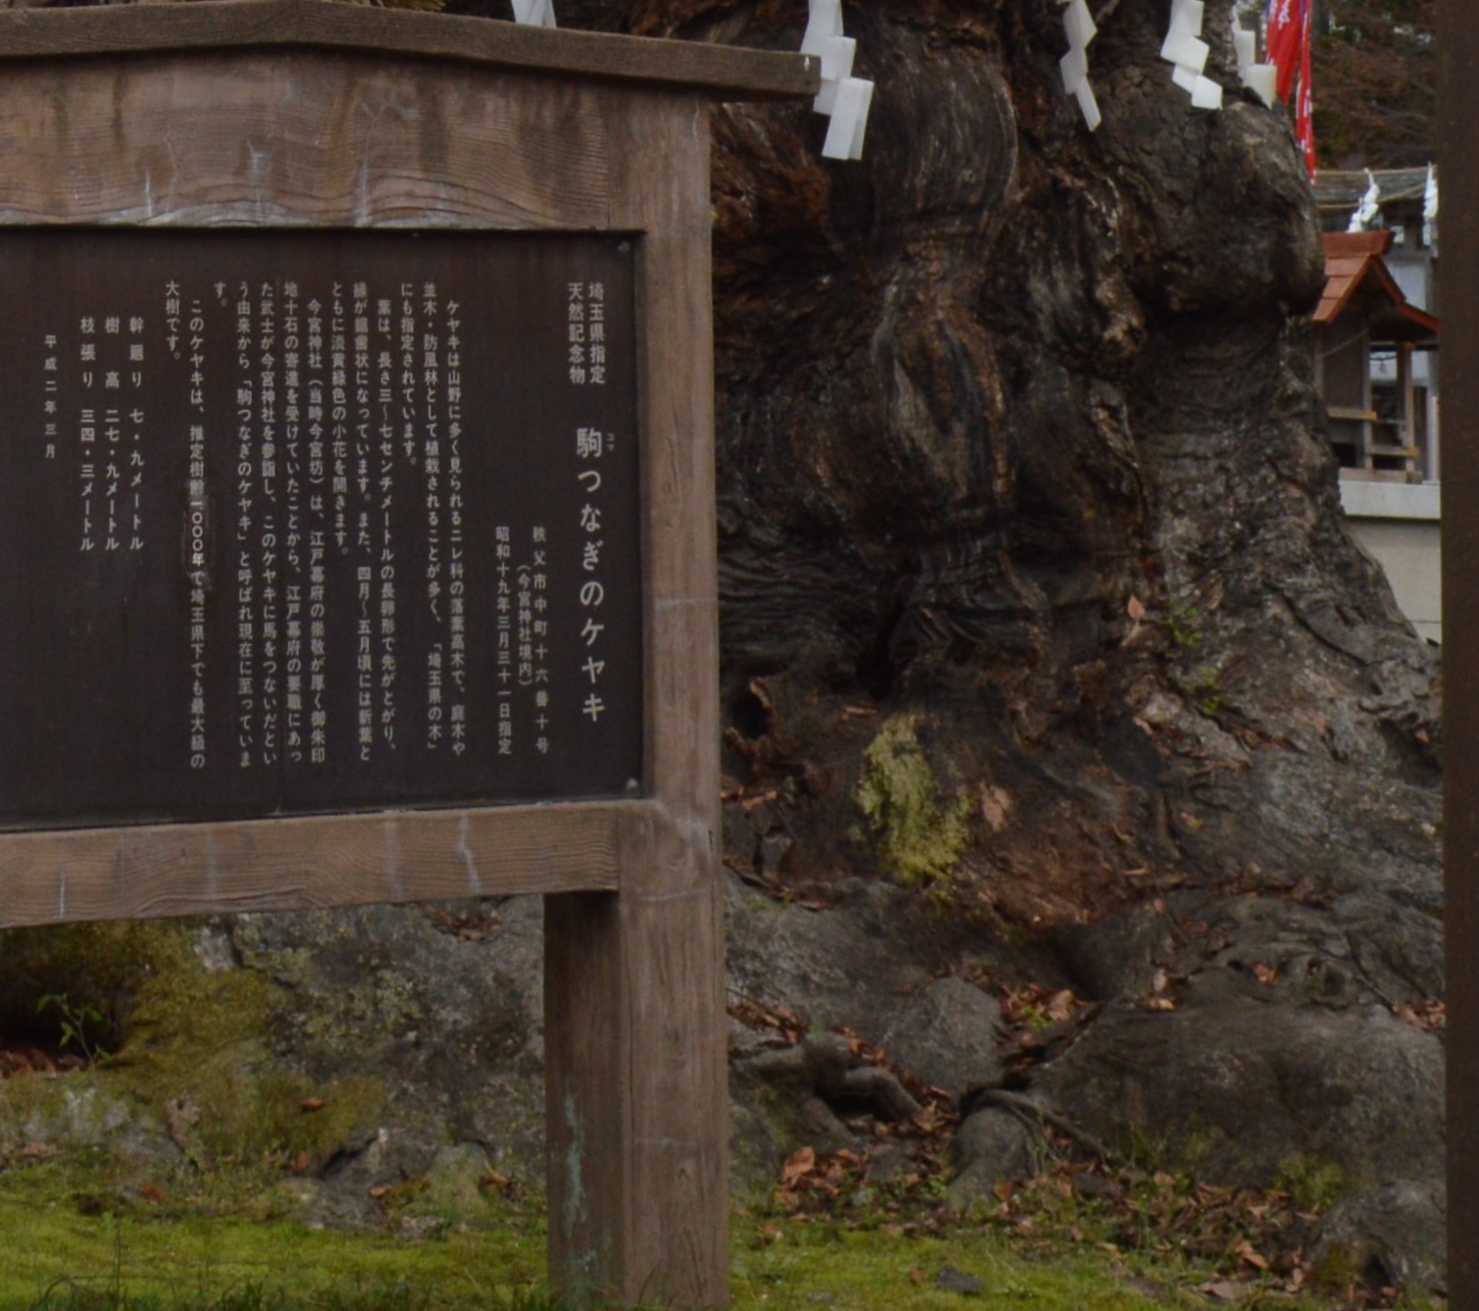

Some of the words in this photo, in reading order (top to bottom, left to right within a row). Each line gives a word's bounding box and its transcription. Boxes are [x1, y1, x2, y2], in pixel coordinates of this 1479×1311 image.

[165, 280, 181, 360] 大樹です。
[401, 283, 417, 466] にも指定されています。
[568, 281, 586, 385] 天然記念物
[589, 281, 606, 385] 埼玉県指定
[44, 334, 59, 459] 平成二年三月
[576, 427, 606, 723] 駒つなぎのケヤキ
[495, 525, 512, 756] 昭和十九年三月三十一日指定
